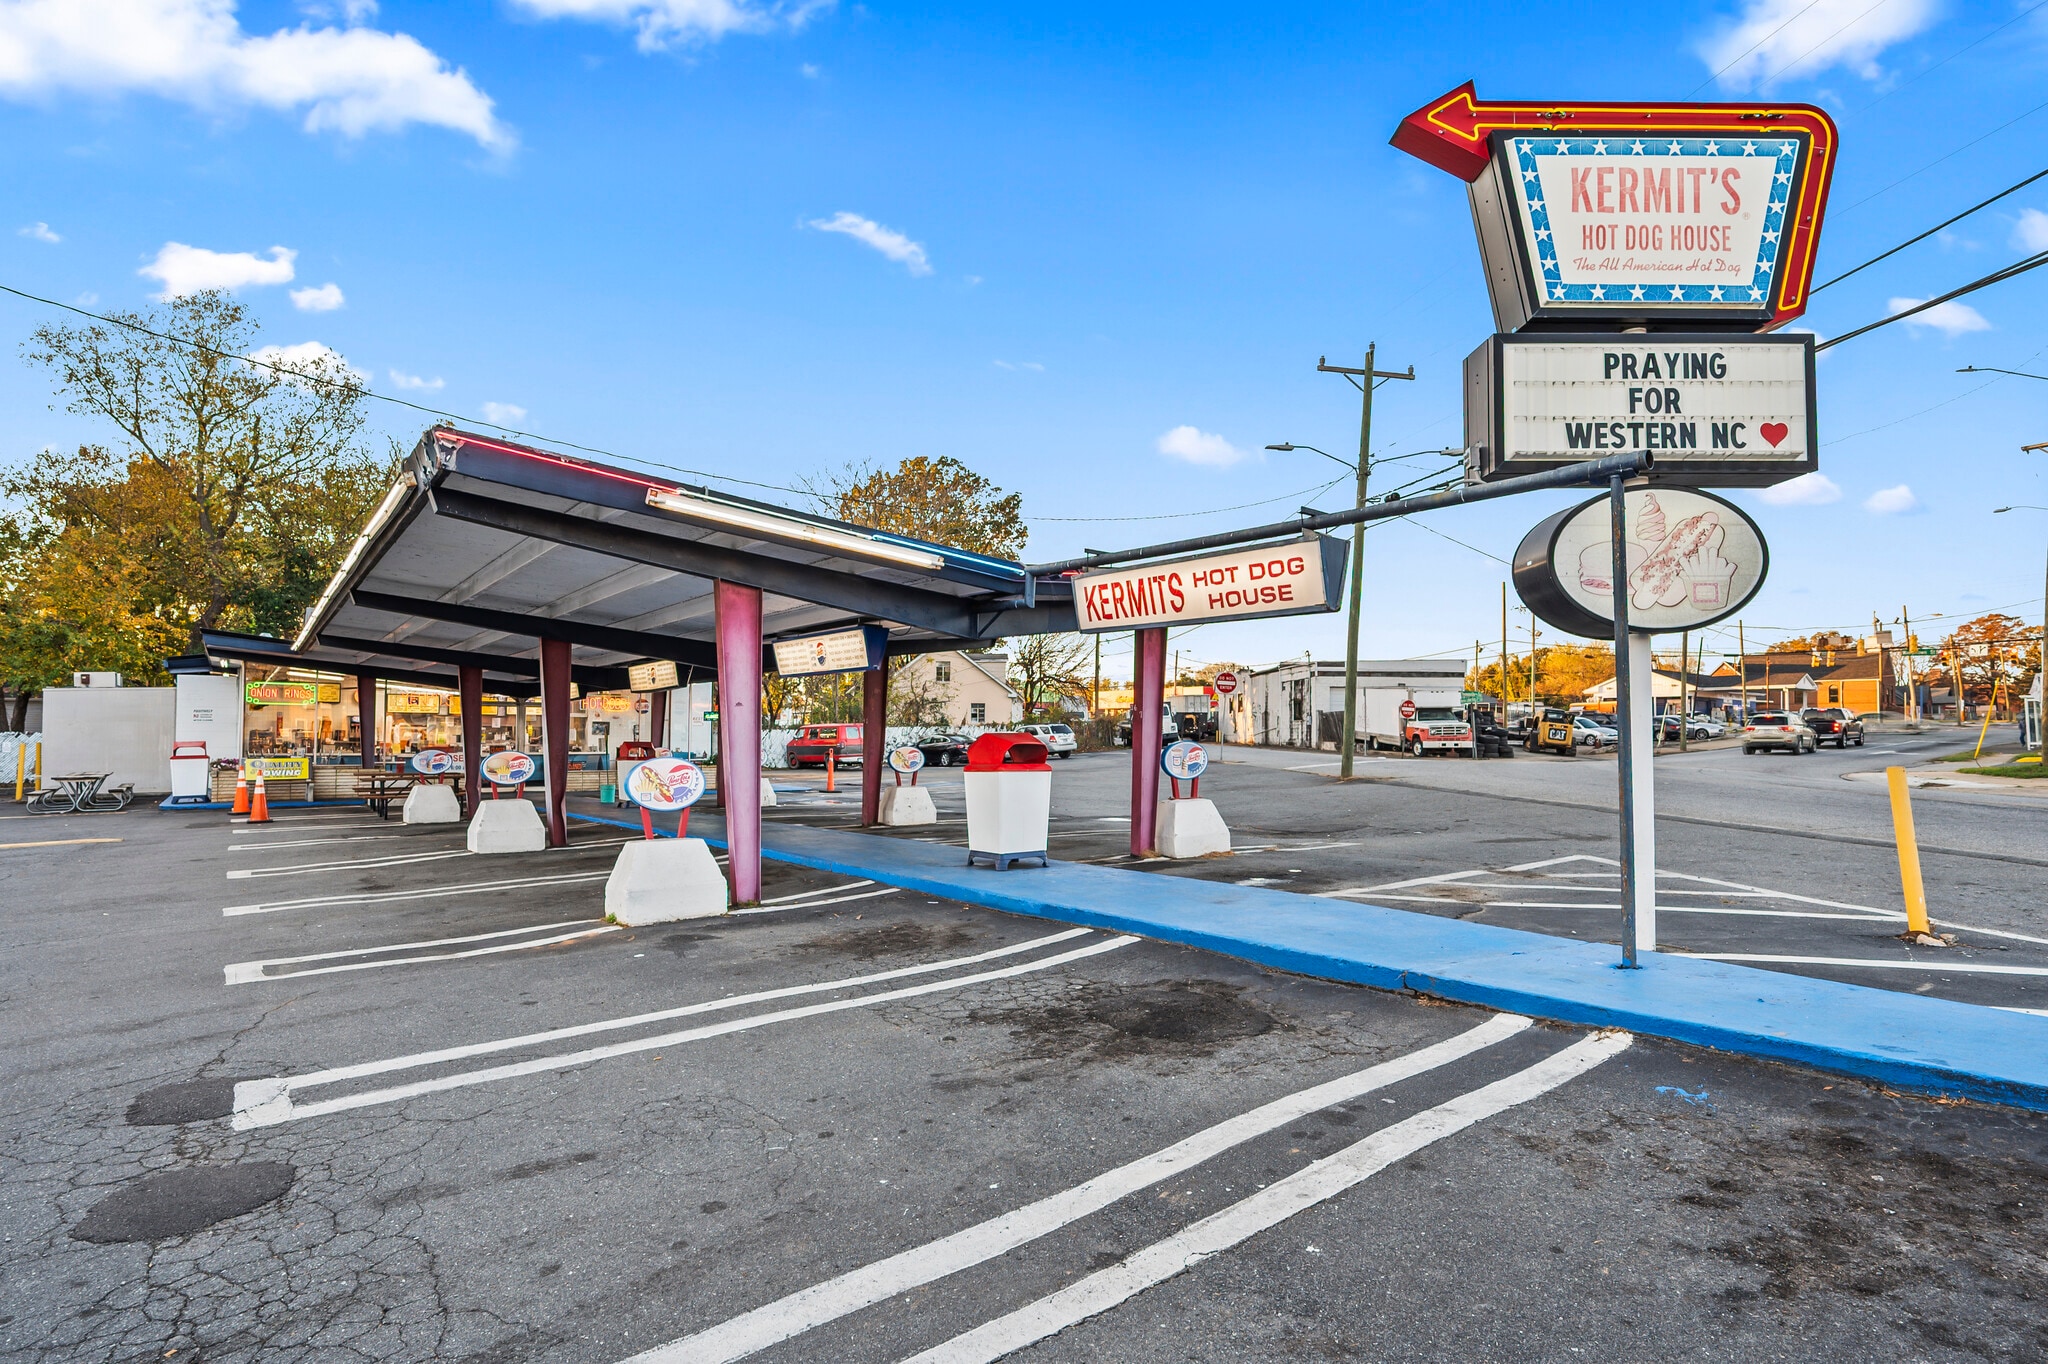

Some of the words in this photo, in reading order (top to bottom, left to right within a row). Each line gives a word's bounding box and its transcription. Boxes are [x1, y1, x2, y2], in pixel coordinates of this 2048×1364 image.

[1571, 166, 1742, 216] KERMIT'S
[1582, 224, 1618, 251] HOT
[1625, 224, 1663, 251] DOG
[1670, 225, 1732, 252] HOUSE
[1573, 257, 1596, 271] The
[1599, 257, 1620, 271] All
[1622, 257, 1683, 272] American
[1685, 258, 1713, 272] Hot
[1714, 258, 1742, 277] Dog
[1604, 352, 1727, 380] PRAYING
[1629, 387, 1682, 414] FOR
[1565, 422, 1697, 449] WESTERN
[1711, 422, 1747, 449] NC
[1083, 572, 1185, 623] KERMITS
[1192, 566, 1239, 588] HOT
[1249, 556, 1305, 581] DOG
[1208, 584, 1294, 610] HOUSE
[250, 688, 278, 698] ONION
[284, 689, 312, 699] RINGS
[582, 697, 601, 710] HOT
[602, 697, 629, 711] DOGS
[1549, 729, 1567, 741] CAT
[250, 760, 304, 769] QUALITY
[262, 769, 302, 777] OWING
